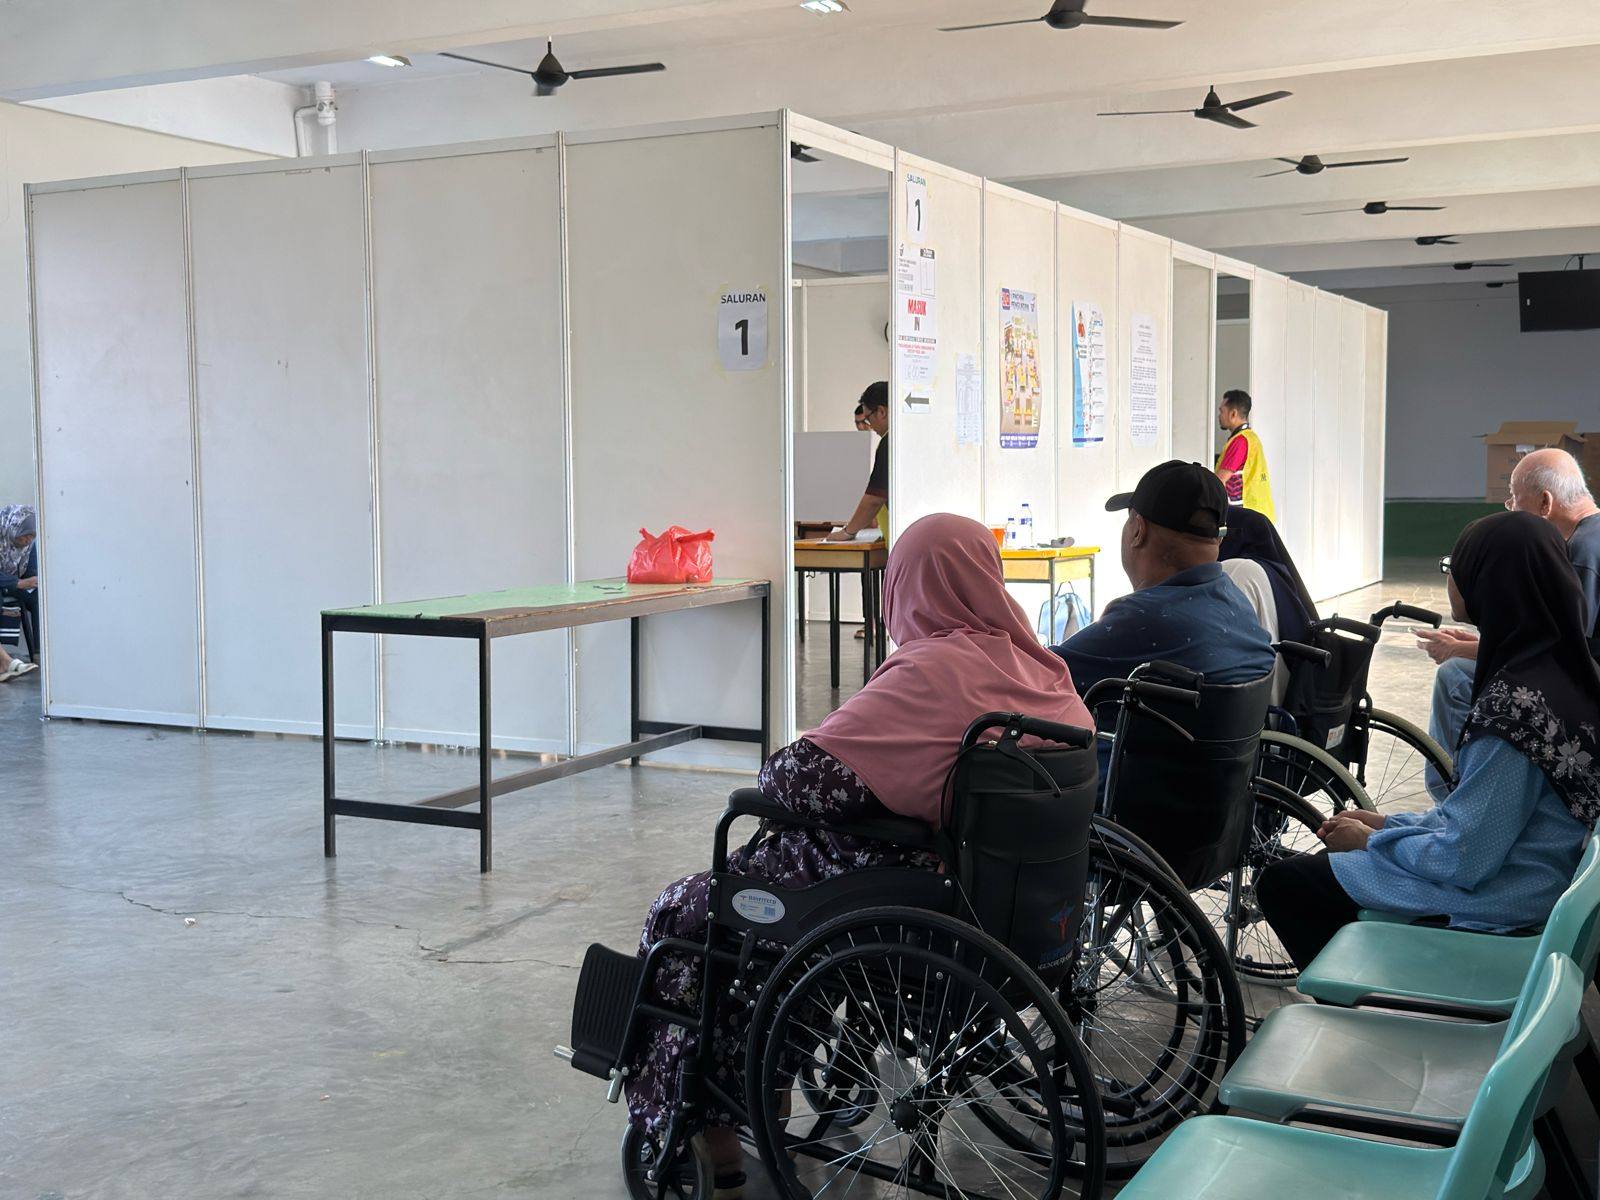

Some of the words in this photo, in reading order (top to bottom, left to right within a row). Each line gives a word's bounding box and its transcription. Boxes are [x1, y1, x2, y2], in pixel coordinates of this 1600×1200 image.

[907, 174, 926, 185] SALURAN
[915, 198, 921, 231] 1
[721, 293, 766, 304] SALURAN
[908, 299, 926, 316] MASUK
[914, 317, 920, 331] IN
[735, 319, 749, 356] 1
